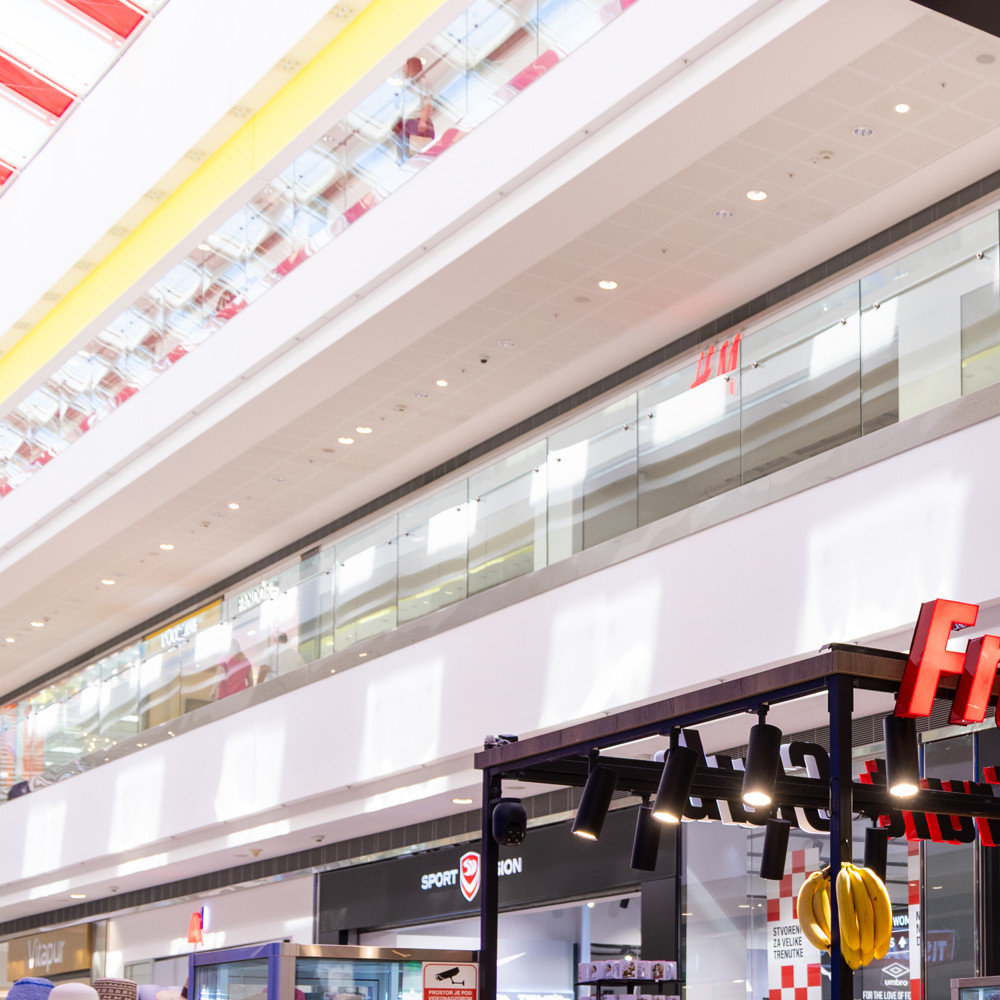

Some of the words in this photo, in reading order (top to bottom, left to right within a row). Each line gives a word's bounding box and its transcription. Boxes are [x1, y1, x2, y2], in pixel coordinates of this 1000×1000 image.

[421, 869, 458, 890] SPORT
[773, 938, 781, 948] ZA
[782, 936, 802, 947] VELIKE
[27, 937, 66, 972] Vitapur
[773, 947, 804, 959] TRENUTKE
[884, 978, 909, 987] umbro
[862, 990, 873, 1000] FOR
[873, 990, 883, 999] THE
[883, 990, 897, 999] LOVE
[897, 990, 904, 999] OF
